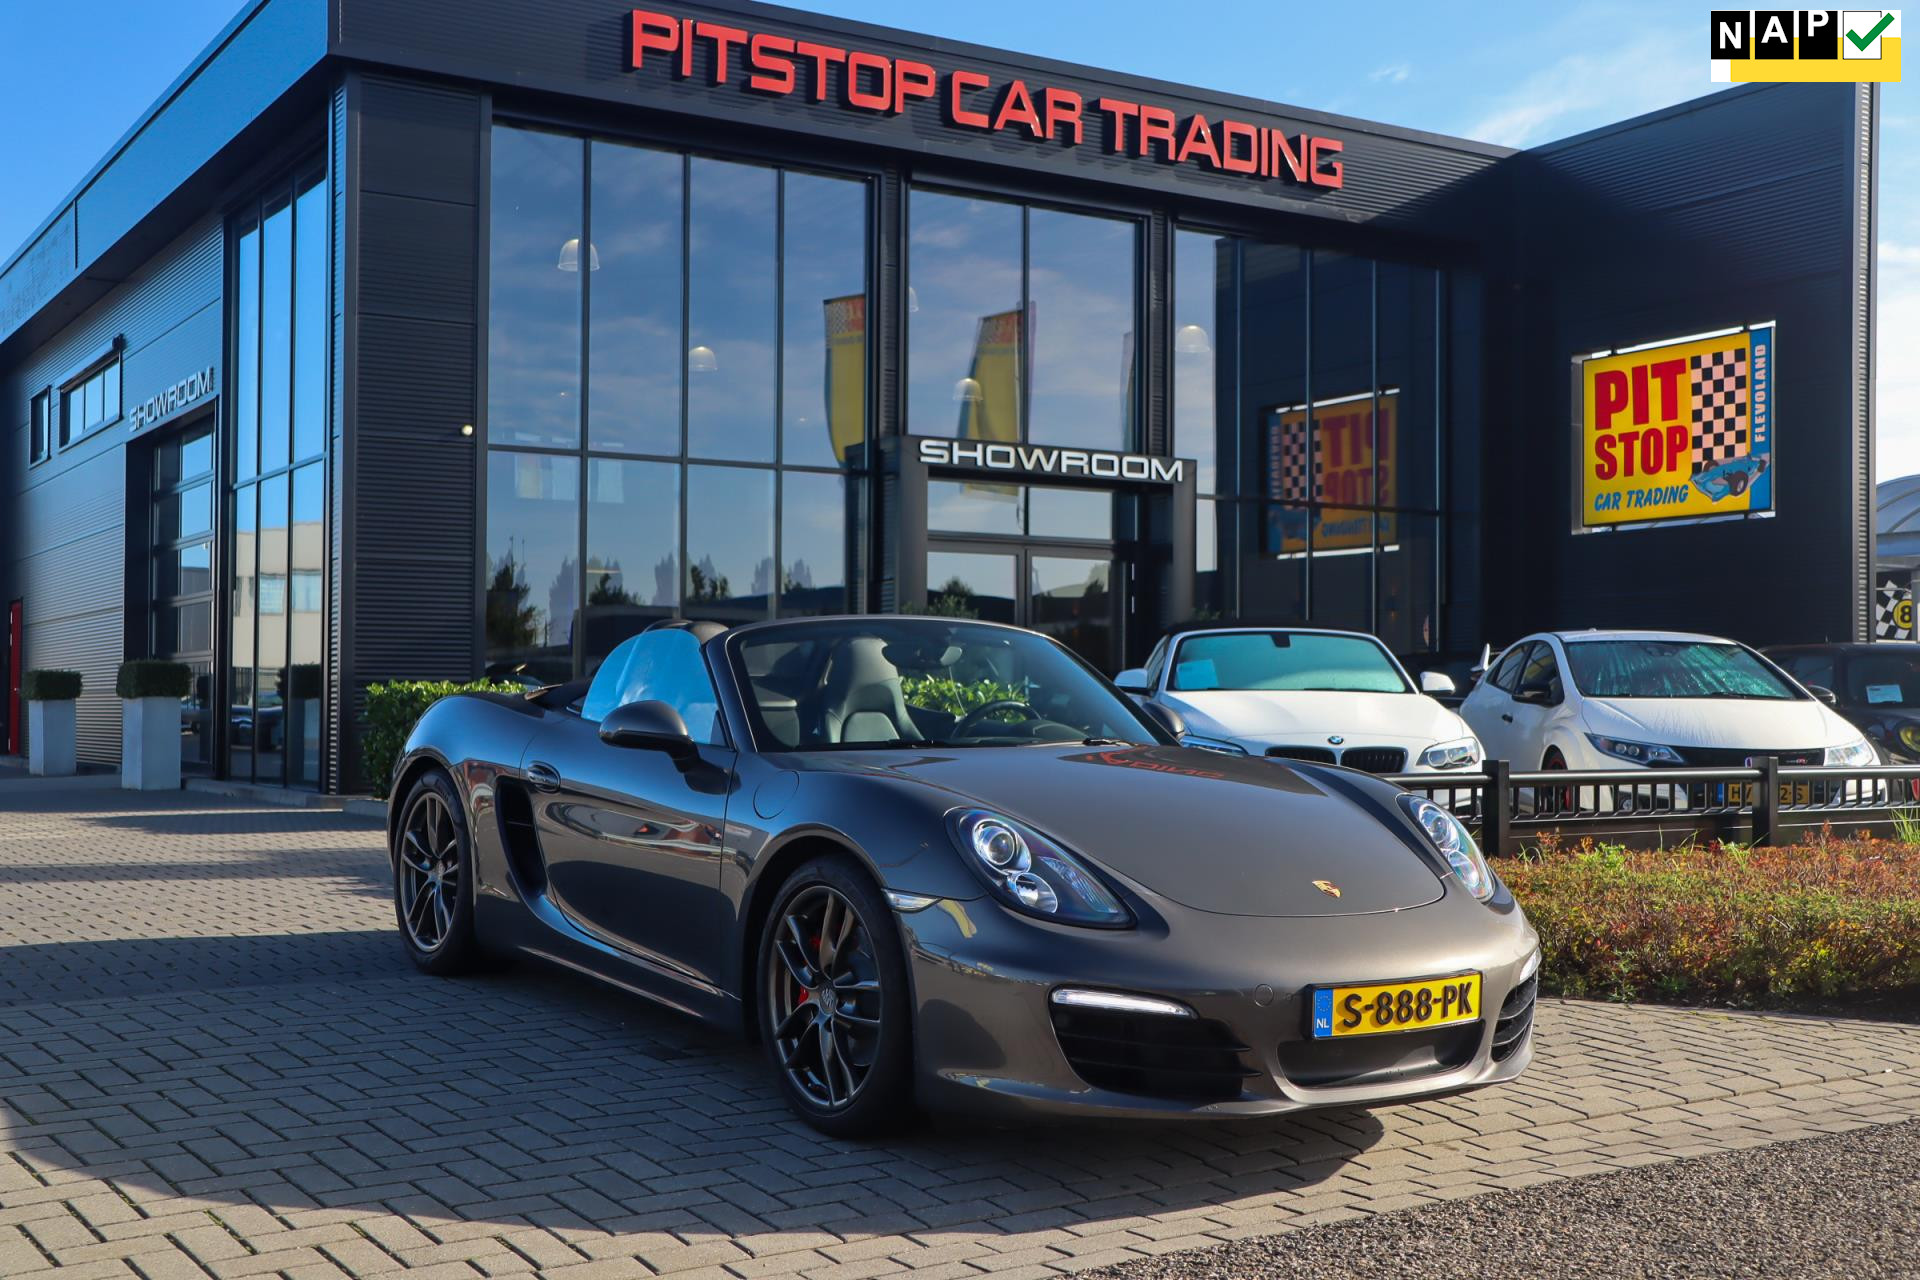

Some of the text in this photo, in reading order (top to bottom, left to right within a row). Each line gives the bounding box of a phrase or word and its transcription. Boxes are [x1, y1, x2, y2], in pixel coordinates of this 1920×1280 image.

[631, 9, 1343, 189] PITSTOP CAR TRADING
[129, 366, 210, 432] SHOWROOM
[1594, 358, 1687, 430] PIT
[1754, 344, 1766, 442] FLEVOLAND
[919, 439, 1183, 482] SHOWROOM
[1595, 425, 1689, 480] STOP
[1594, 484, 1689, 511] CAR TRADING
[1316, 1018, 1330, 1029] NL
[1343, 981, 1473, 1028] S-888-PK
